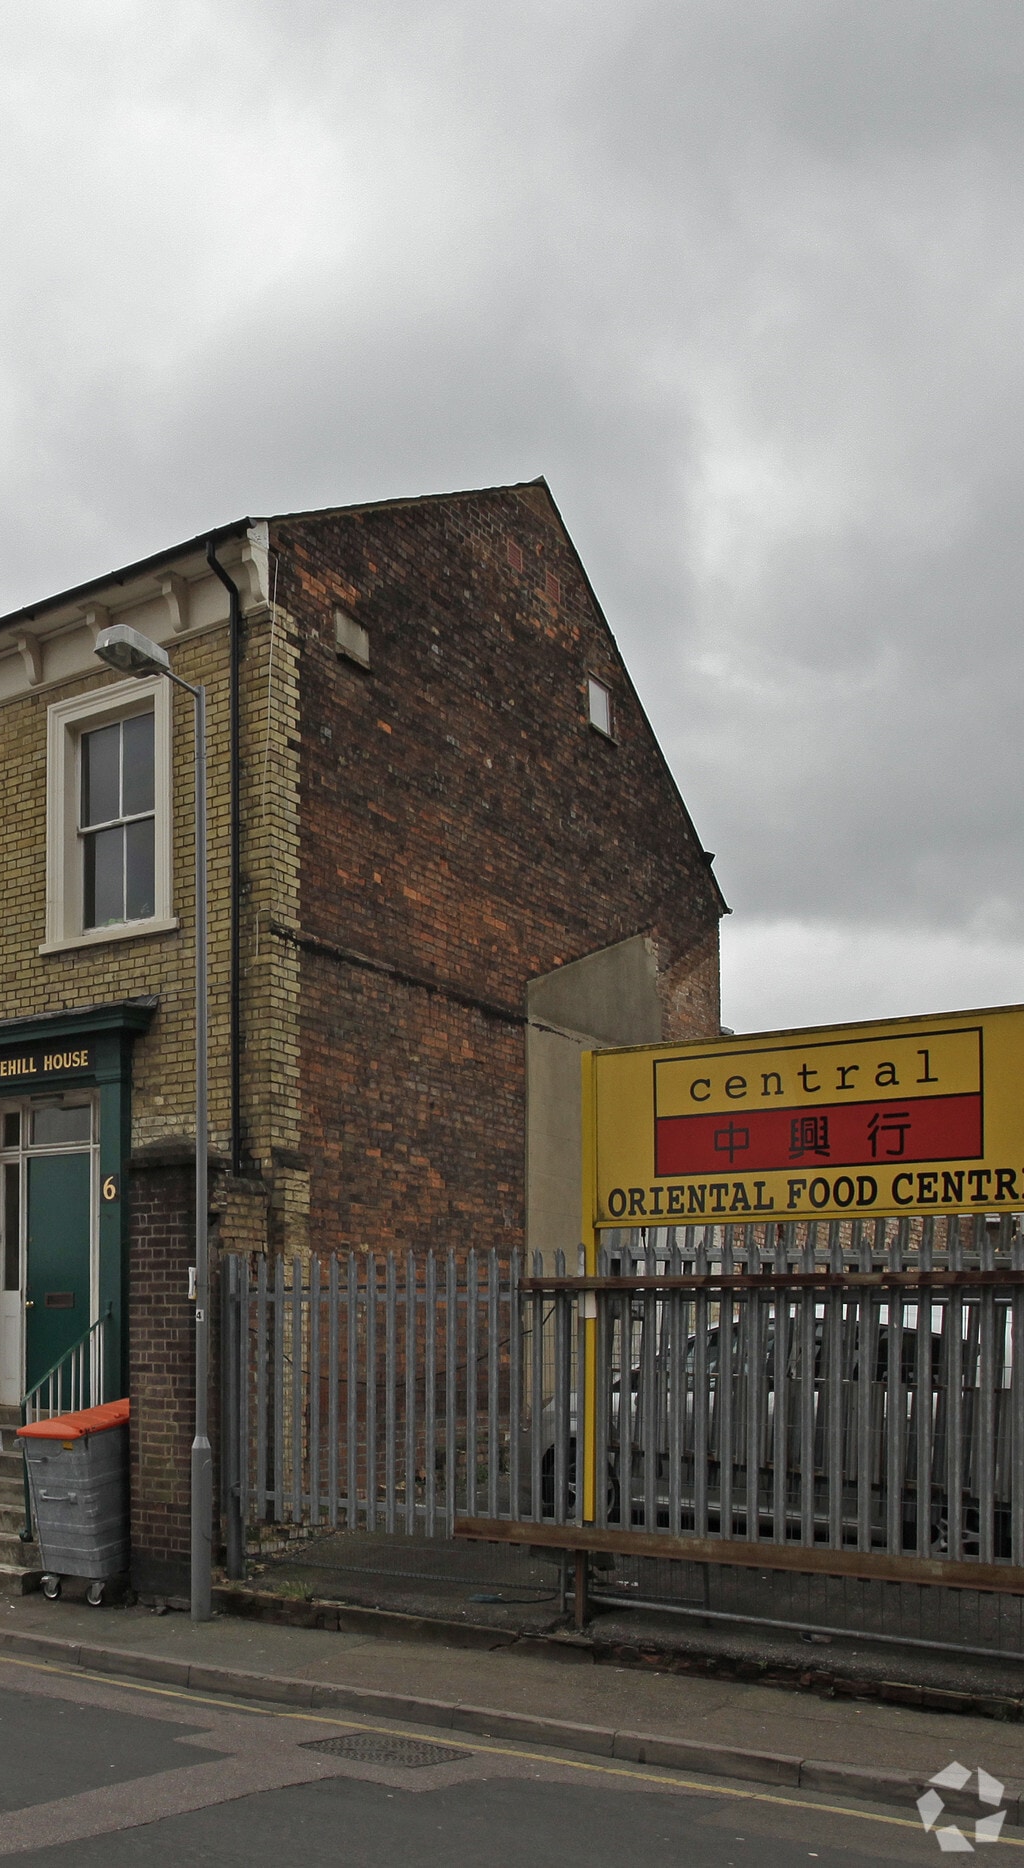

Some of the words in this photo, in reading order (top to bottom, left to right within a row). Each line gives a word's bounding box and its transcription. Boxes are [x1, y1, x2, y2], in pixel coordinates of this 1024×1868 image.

[43, 1050, 89, 1071] HOUSE
[689, 1049, 939, 1102] central
[103, 1176, 116, 1200] 6
[608, 1181, 774, 1217] ORIENTAL
[787, 1175, 878, 1209] FOOD
[891, 1168, 1024, 1206] CENTR
